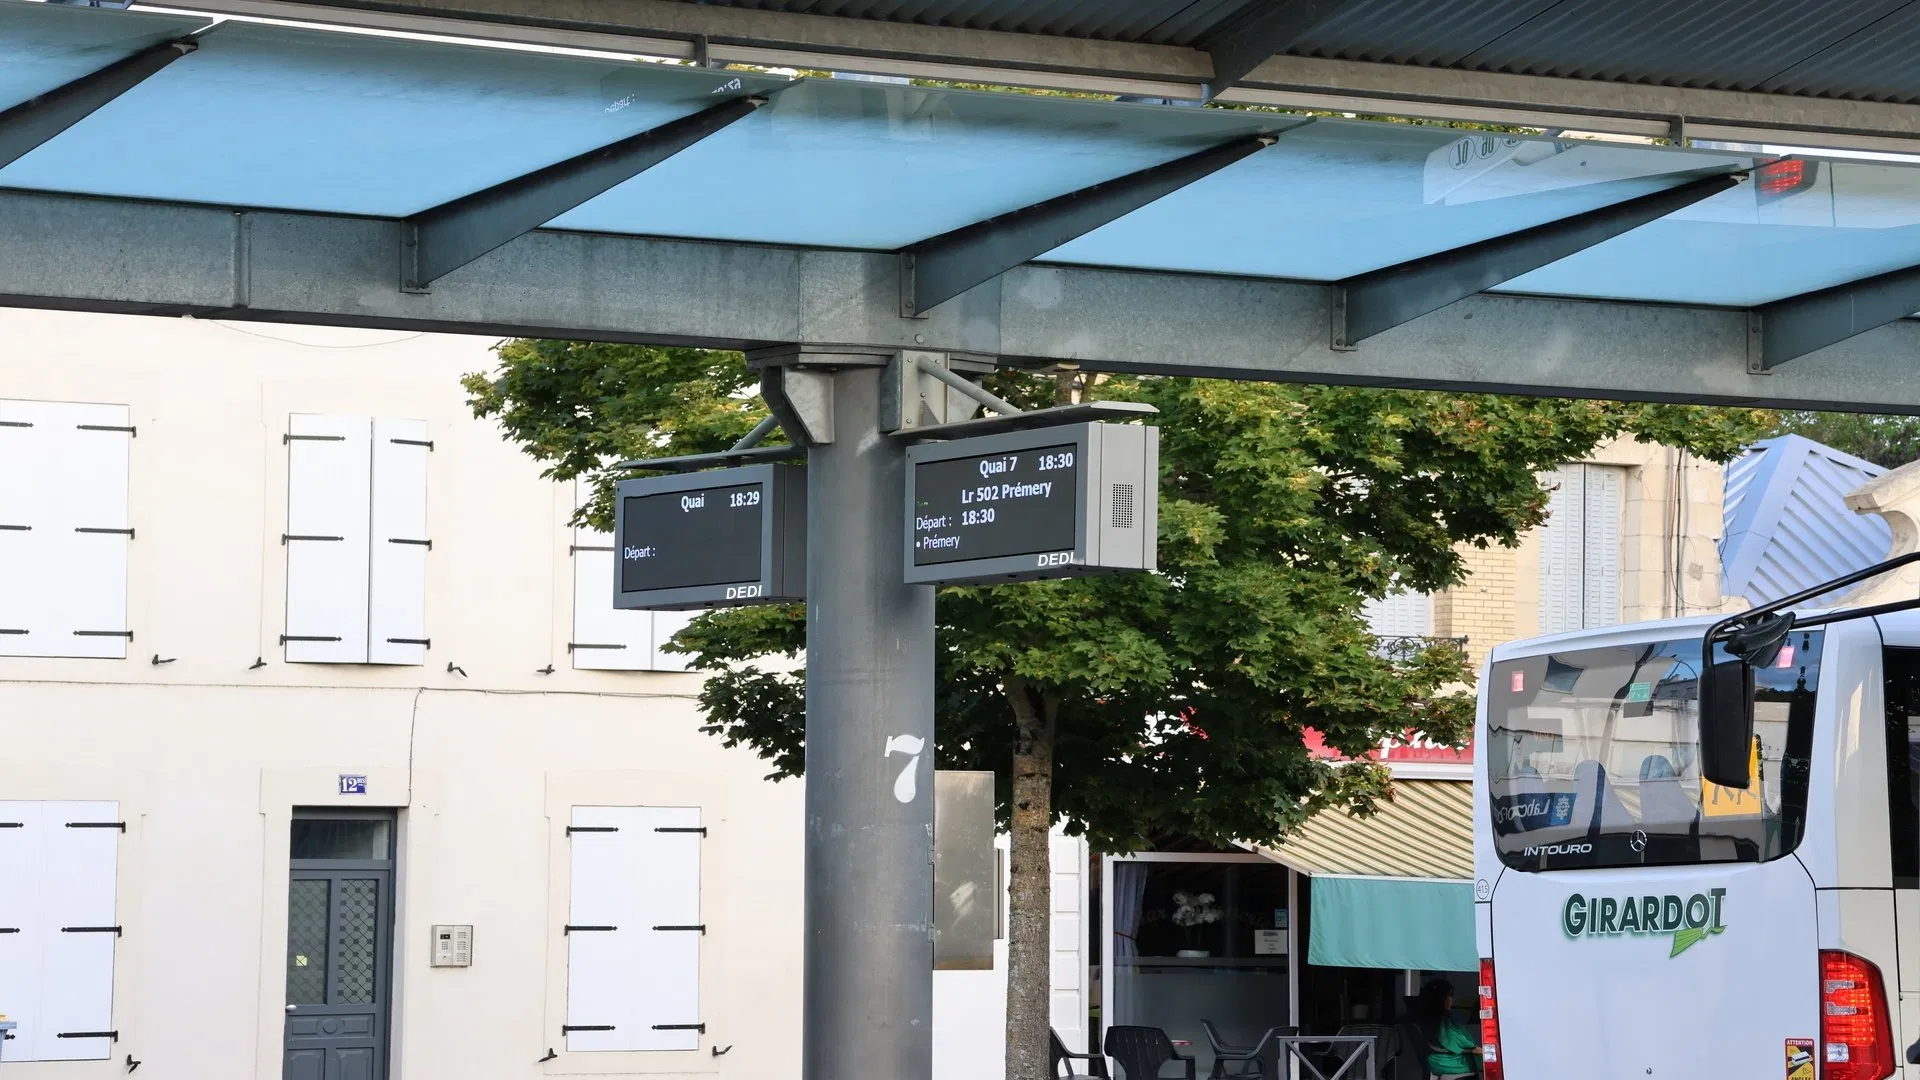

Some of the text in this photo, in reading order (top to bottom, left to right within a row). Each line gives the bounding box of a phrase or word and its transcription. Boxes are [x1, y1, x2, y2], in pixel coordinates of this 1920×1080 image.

[979, 452, 1074, 478] Quai 7 18:30
[681, 490, 760, 513] Quai 18:29
[961, 481, 1052, 504] Lr 502 Prémery
[916, 515, 946, 532] Départ
[961, 508, 995, 526] 18:30
[923, 534, 960, 550] Prémery
[624, 545, 651, 561] Départ
[1037, 552, 1074, 567] DEDI
[726, 585, 762, 600] DEDI
[884, 734, 925, 803] 7
[342, 778, 358, 792] 12
[1523, 843, 1593, 857] INTOURO
[1564, 887, 1727, 937] GIRARDOT
